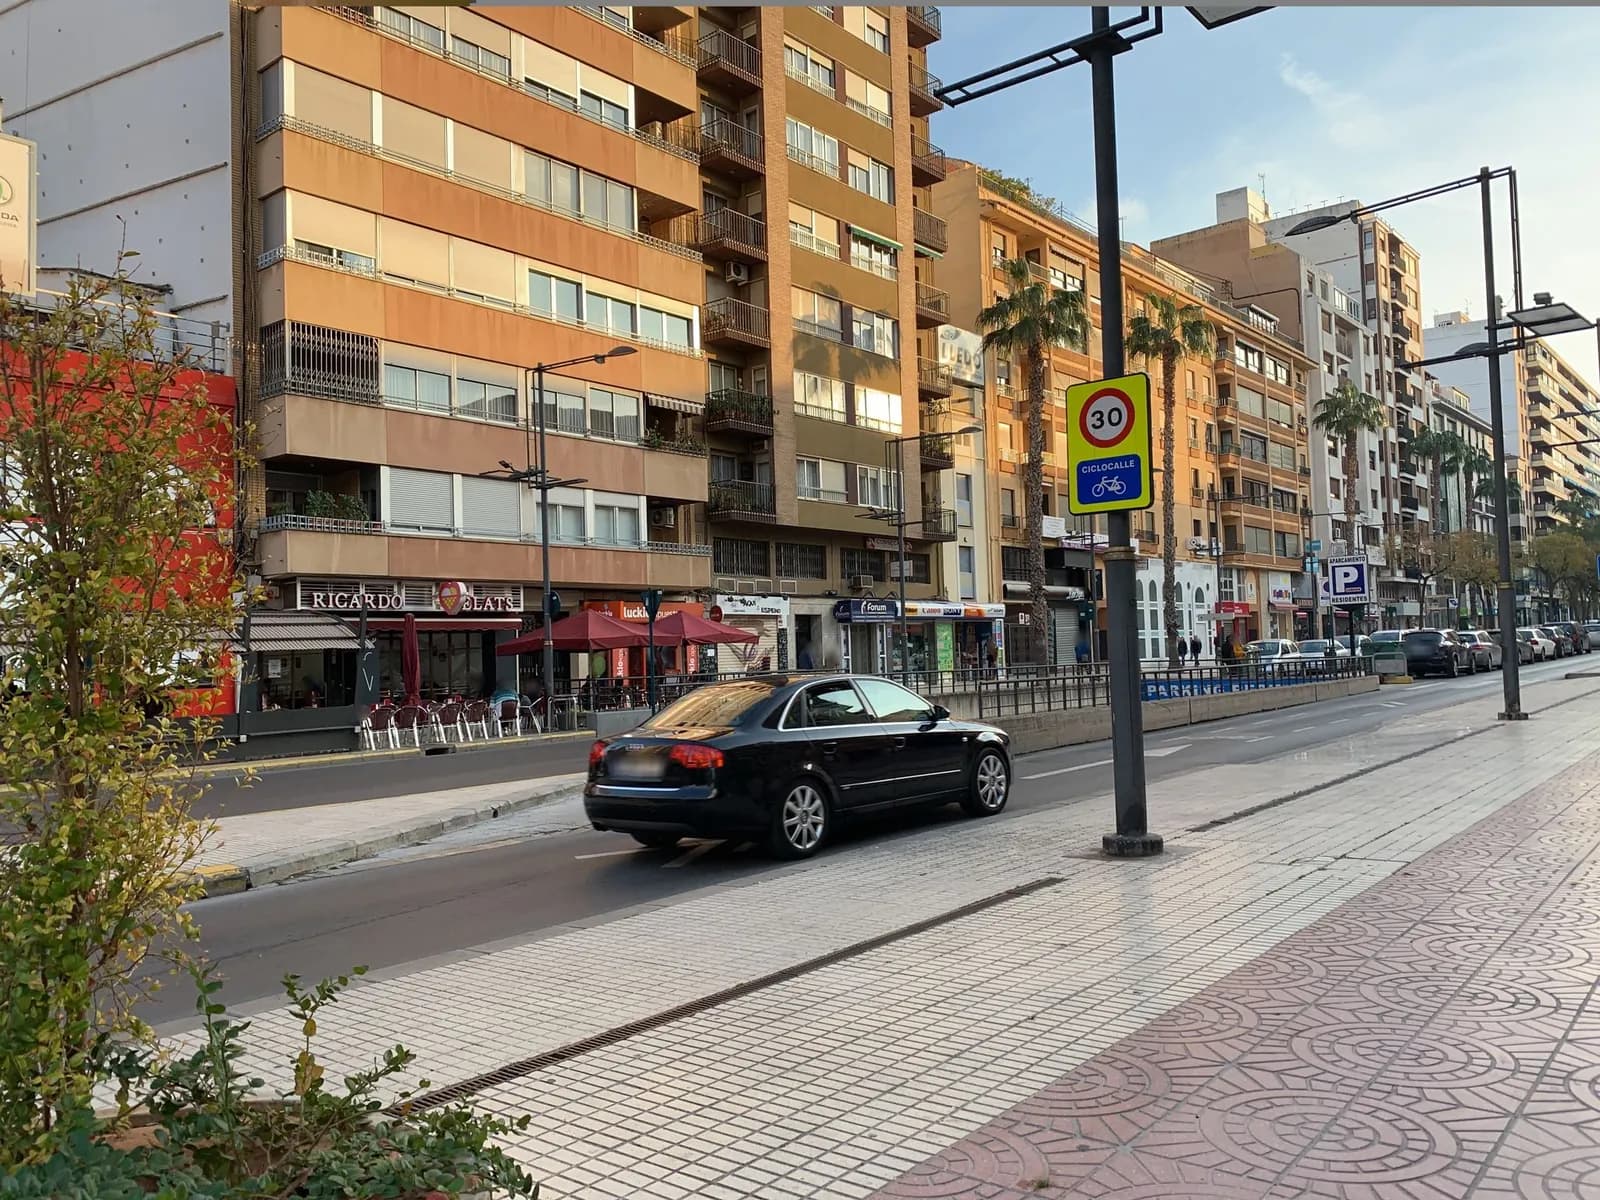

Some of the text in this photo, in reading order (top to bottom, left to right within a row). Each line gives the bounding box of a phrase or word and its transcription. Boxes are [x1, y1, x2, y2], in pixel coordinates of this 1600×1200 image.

[1091, 407, 1123, 429] 30
[1081, 460, 1135, 473] CICLOCALLE
[1334, 566, 1359, 593] P
[312, 592, 514, 610] RICARDO ELATS
[1147, 684, 1225, 697] PARKING
